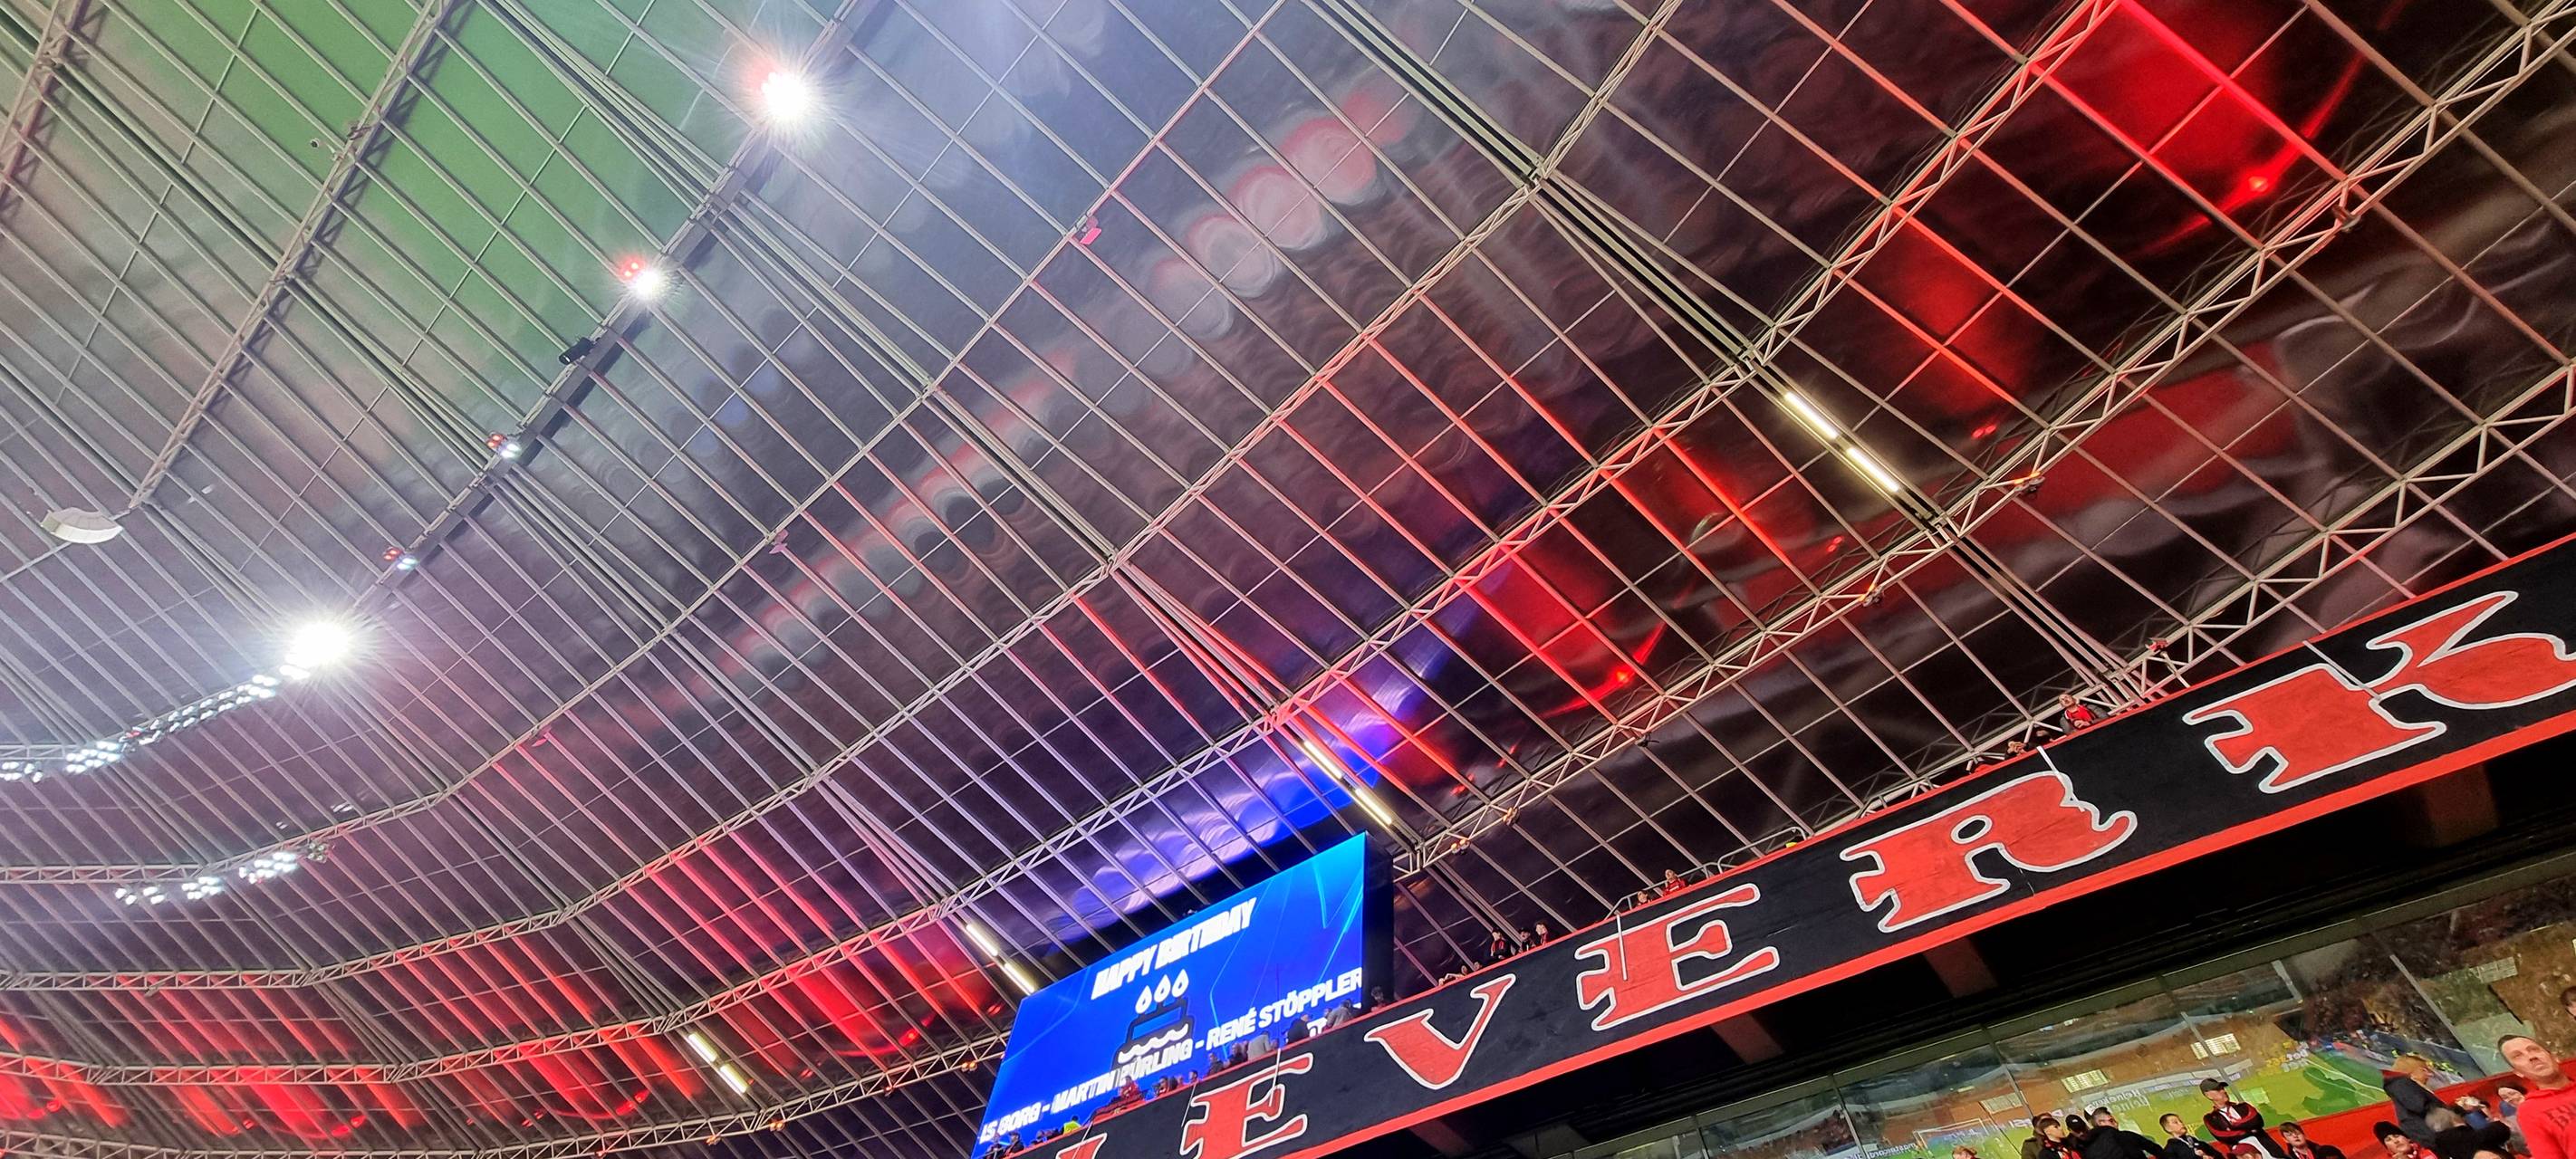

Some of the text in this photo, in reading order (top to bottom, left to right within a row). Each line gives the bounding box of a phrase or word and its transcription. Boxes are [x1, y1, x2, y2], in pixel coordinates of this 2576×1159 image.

[1055, 590, 2576, 1159] EVERK
[1091, 896, 1257, 1000] HAPPY BIRTHDAY
[1050, 1069, 1118, 1114] MARTIN
[1195, 1039, 1205, 1049] -
[1206, 1006, 1257, 1051] RENÉ
[1258, 967, 1362, 1029] STÖPPLER
